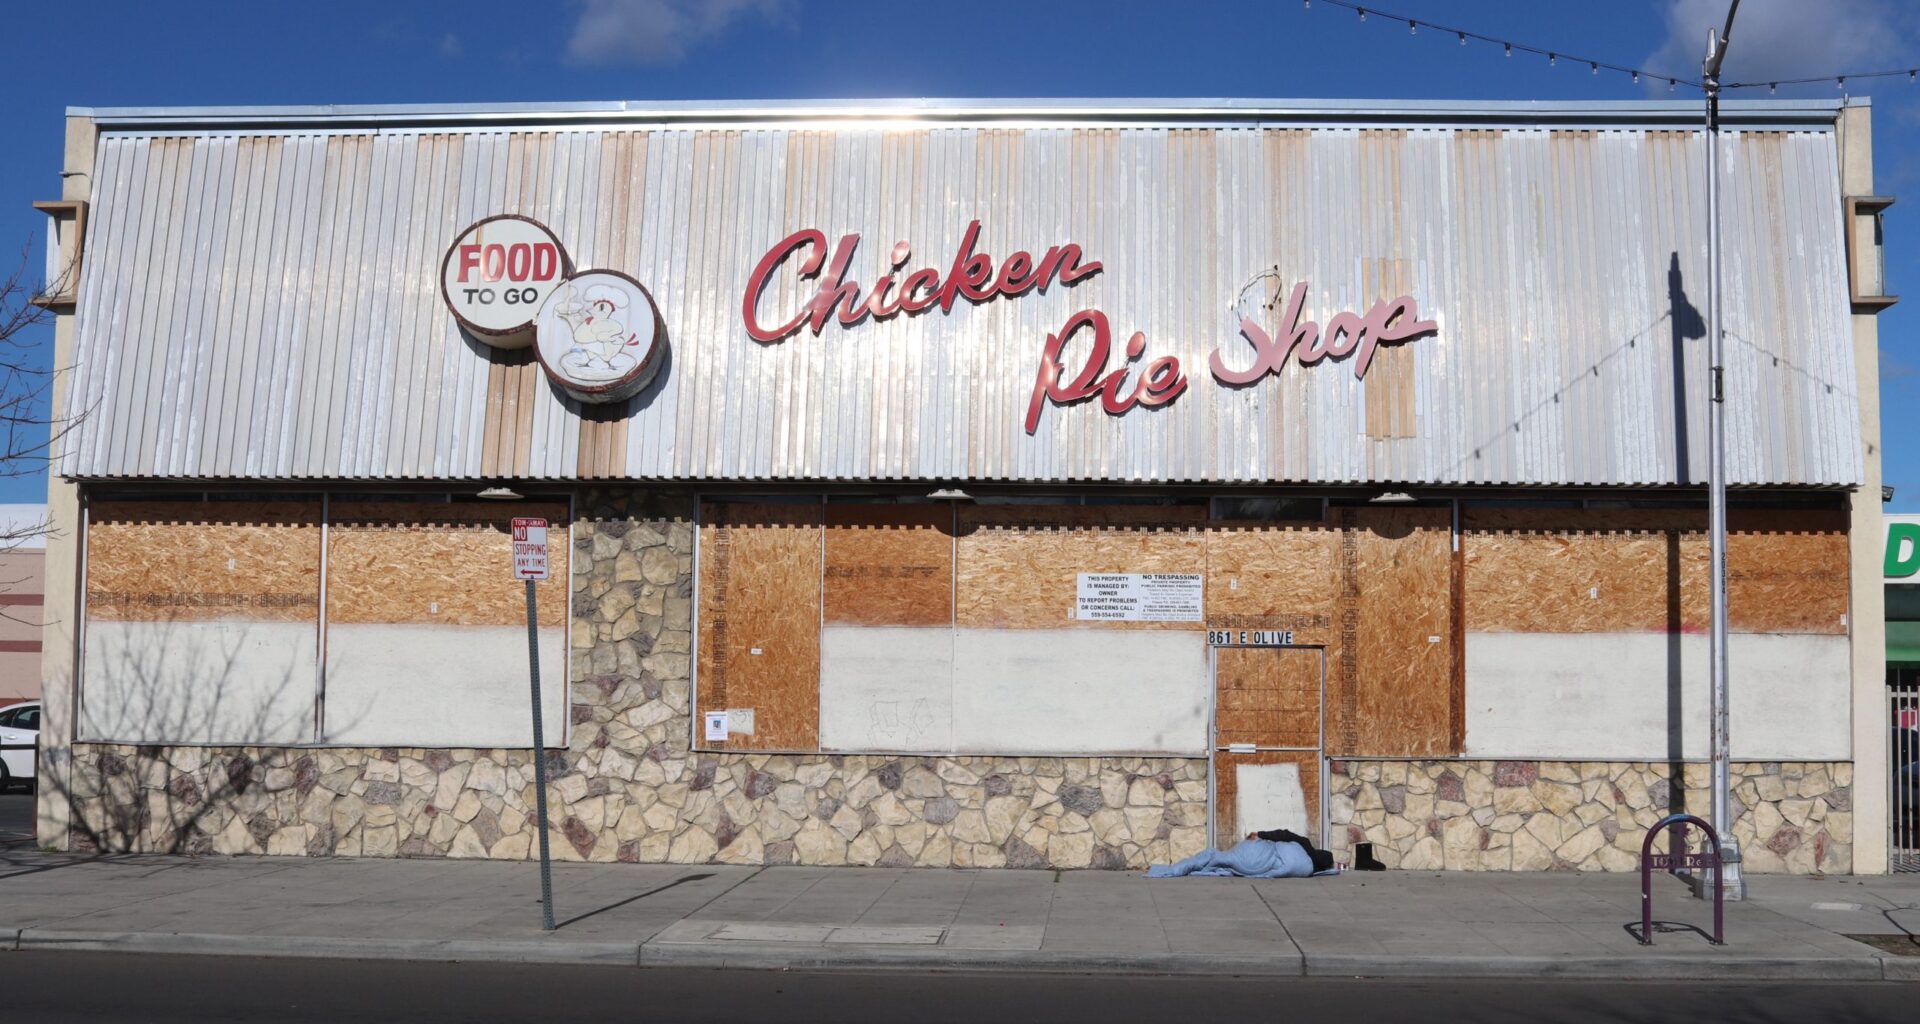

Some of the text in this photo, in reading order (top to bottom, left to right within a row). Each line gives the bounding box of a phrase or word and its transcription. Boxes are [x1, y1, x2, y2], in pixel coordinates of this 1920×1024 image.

[457, 243, 557, 282] FOOD
[741, 219, 1104, 342] Chicken
[463, 288, 538, 305] TO GO
[1024, 278, 1438, 435] Pie Shop
[514, 526, 526, 540] NO
[515, 544, 545, 555] STOPPING
[1883, 522, 1920, 578] D
[518, 558, 545, 567] ANY TIME
[1209, 631, 1292, 644] 861 E OLIVE
